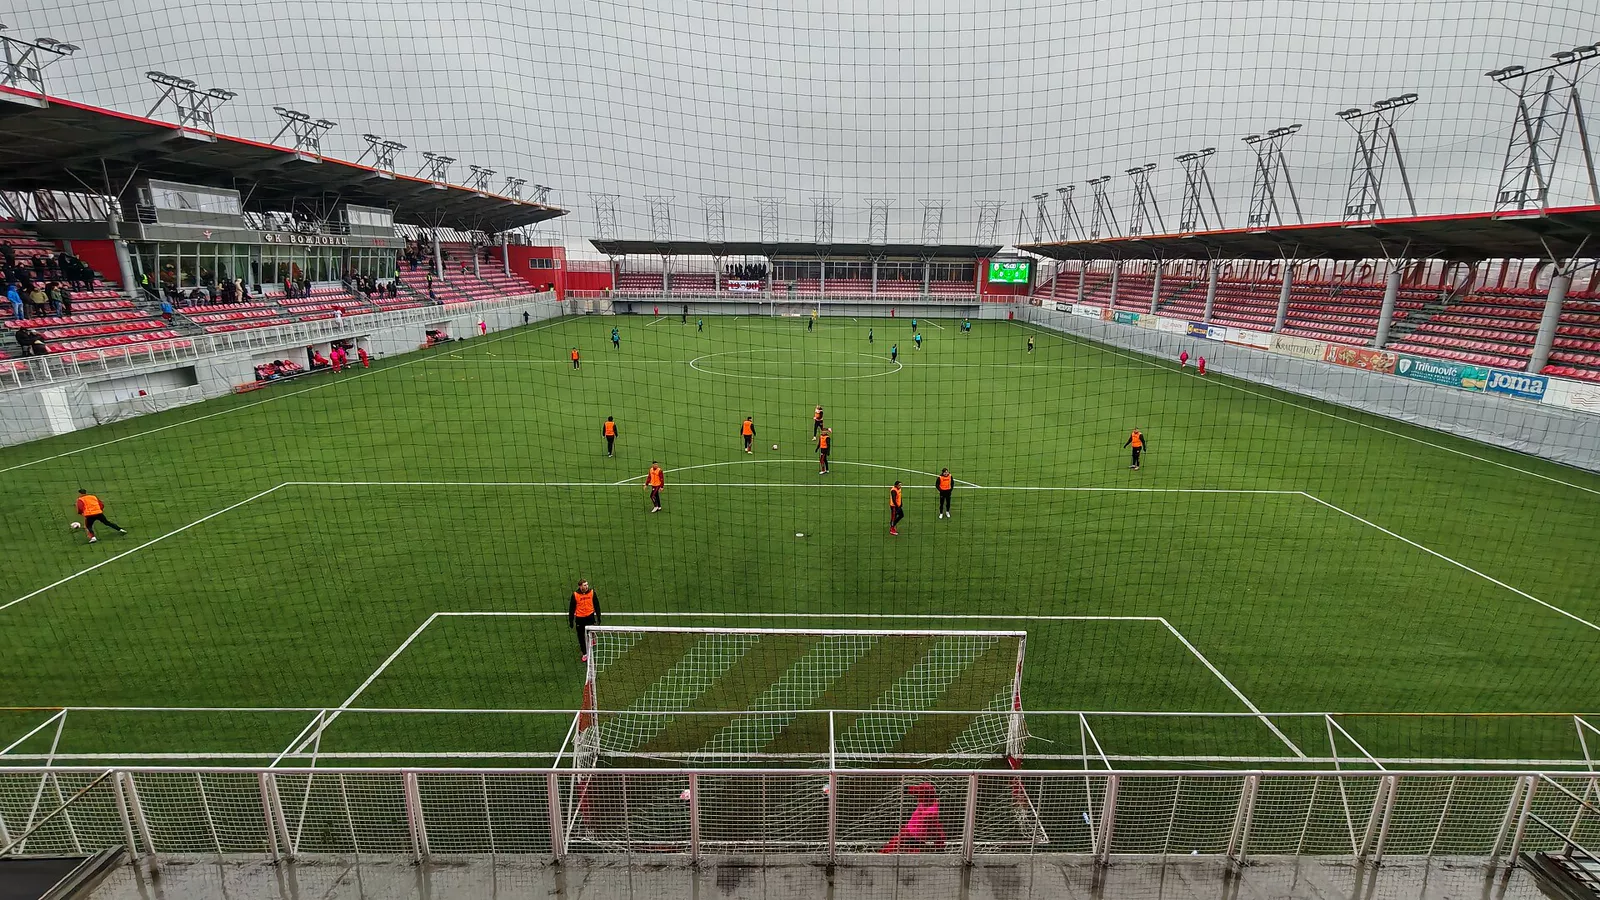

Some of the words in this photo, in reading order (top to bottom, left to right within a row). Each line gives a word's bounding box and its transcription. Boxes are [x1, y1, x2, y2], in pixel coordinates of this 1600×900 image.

[264, 233, 282, 243] ФК
[290, 235, 349, 246] ВОЖДОВАЦ
[1414, 361, 1457, 377] Trifunović
